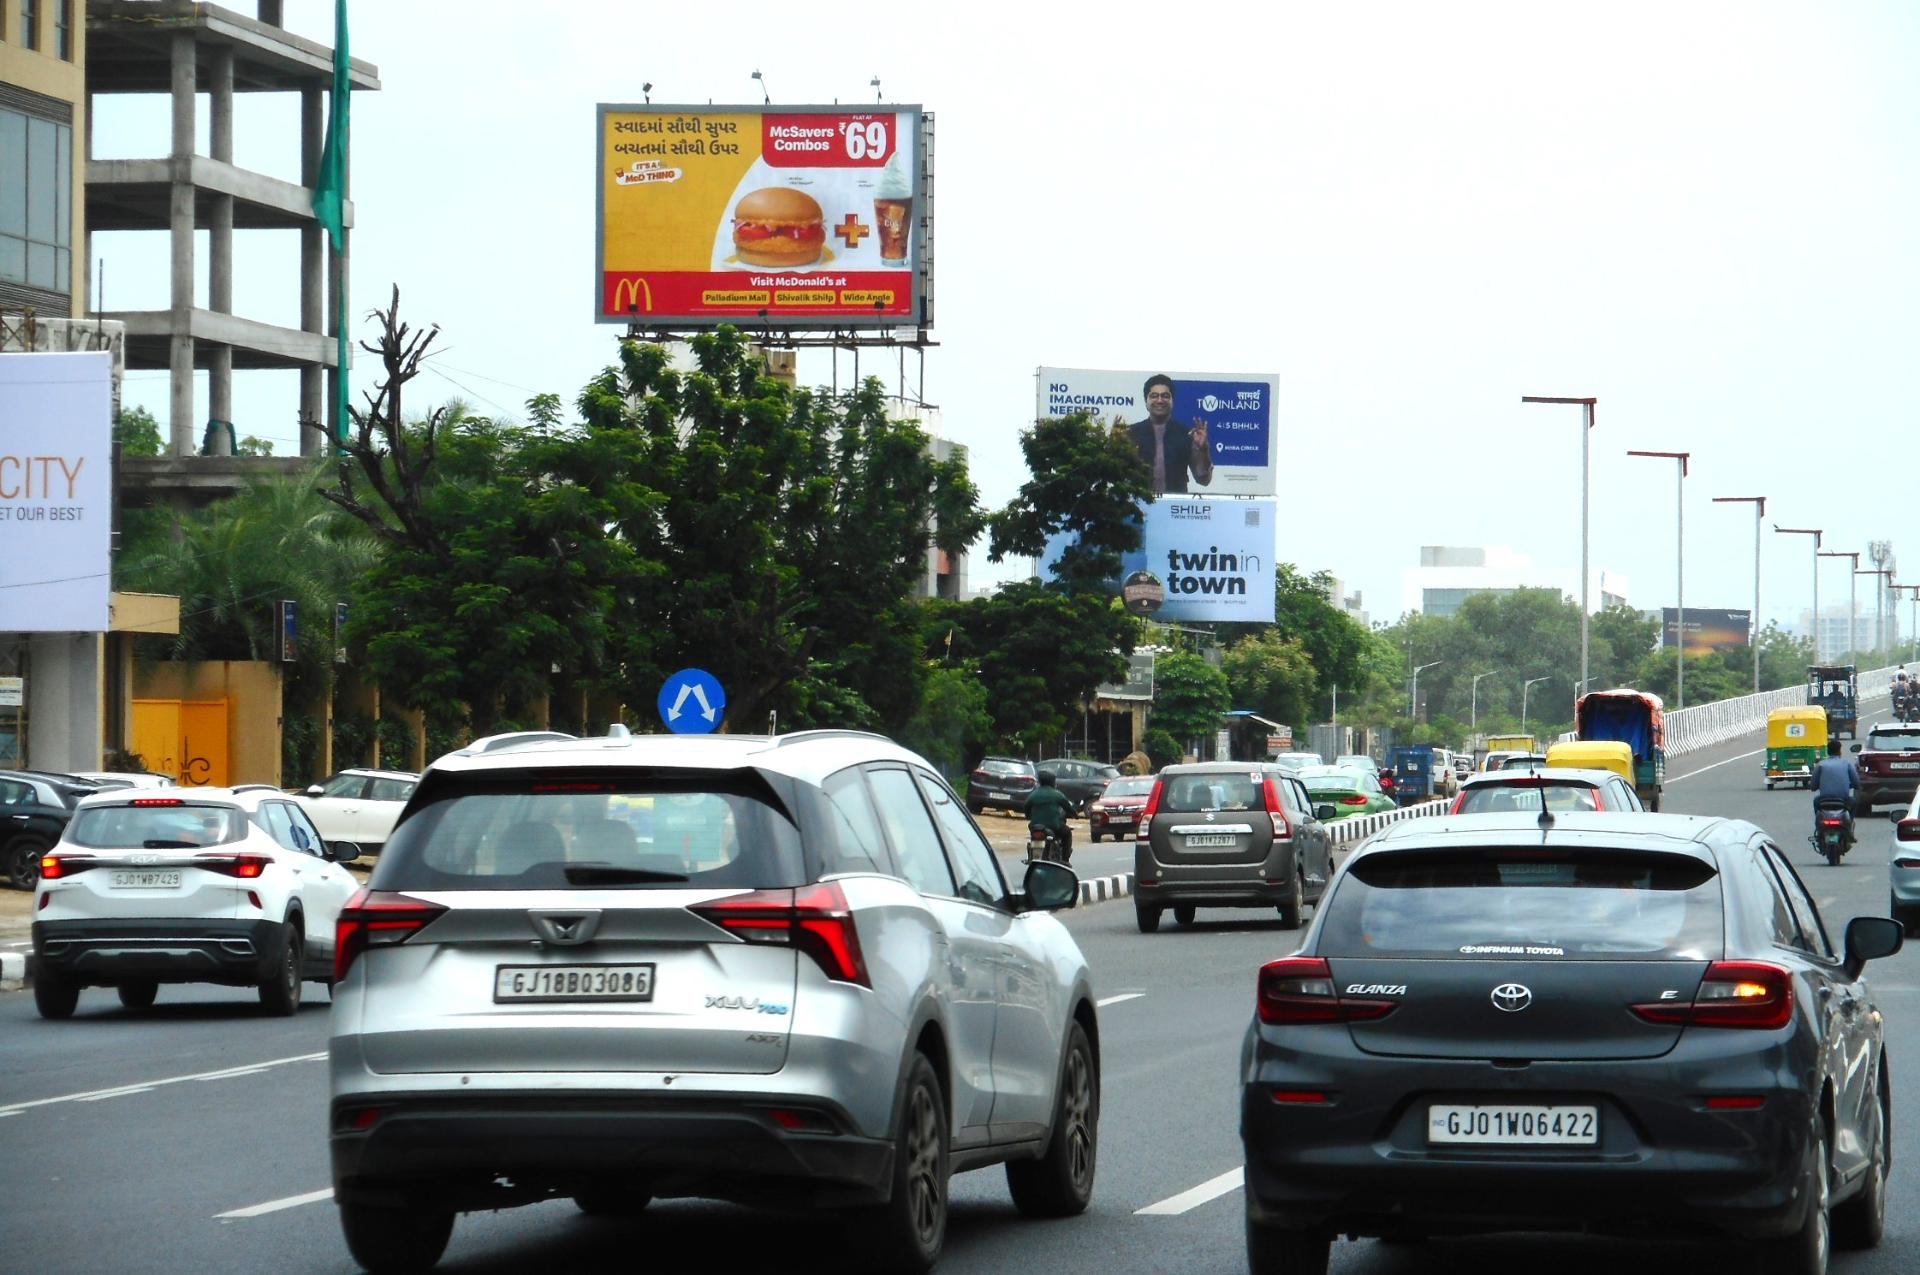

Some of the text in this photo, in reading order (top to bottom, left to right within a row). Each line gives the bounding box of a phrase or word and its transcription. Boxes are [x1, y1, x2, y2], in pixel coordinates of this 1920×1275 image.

[614, 117, 737, 138] સ્વાદમાં સૌથી સુપર
[770, 126, 834, 138] McSavers
[614, 138, 739, 155] બચતમાં સૌથી ઉપર
[774, 139, 830, 151] Combos
[647, 170, 675, 181] THING
[750, 277, 846, 287] Visit McDonald's at
[706, 294, 767, 302] Palladium Mall
[777, 294, 834, 303] Shivalik Shilp
[844, 293, 891, 302] Wide Angle
[1050, 383, 1068, 392] NO
[1049, 394, 1134, 406] IMAGINATION
[1197, 395, 1260, 412] TWINLAND
[0, 456, 84, 499] CITY
[17, 507, 44, 520] OUR
[50, 507, 84, 520] BEST
[1171, 505, 1211, 514] SHILP
[1167, 546, 1260, 572] twin in
[1167, 572, 1246, 595] town
[1476, 946, 1564, 955] INFINIUM TOYOTA
[1346, 984, 1407, 995] GLANZA
[1660, 990, 1679, 999] E
[1448, 1111, 1593, 1137] GJ01WQ6422
